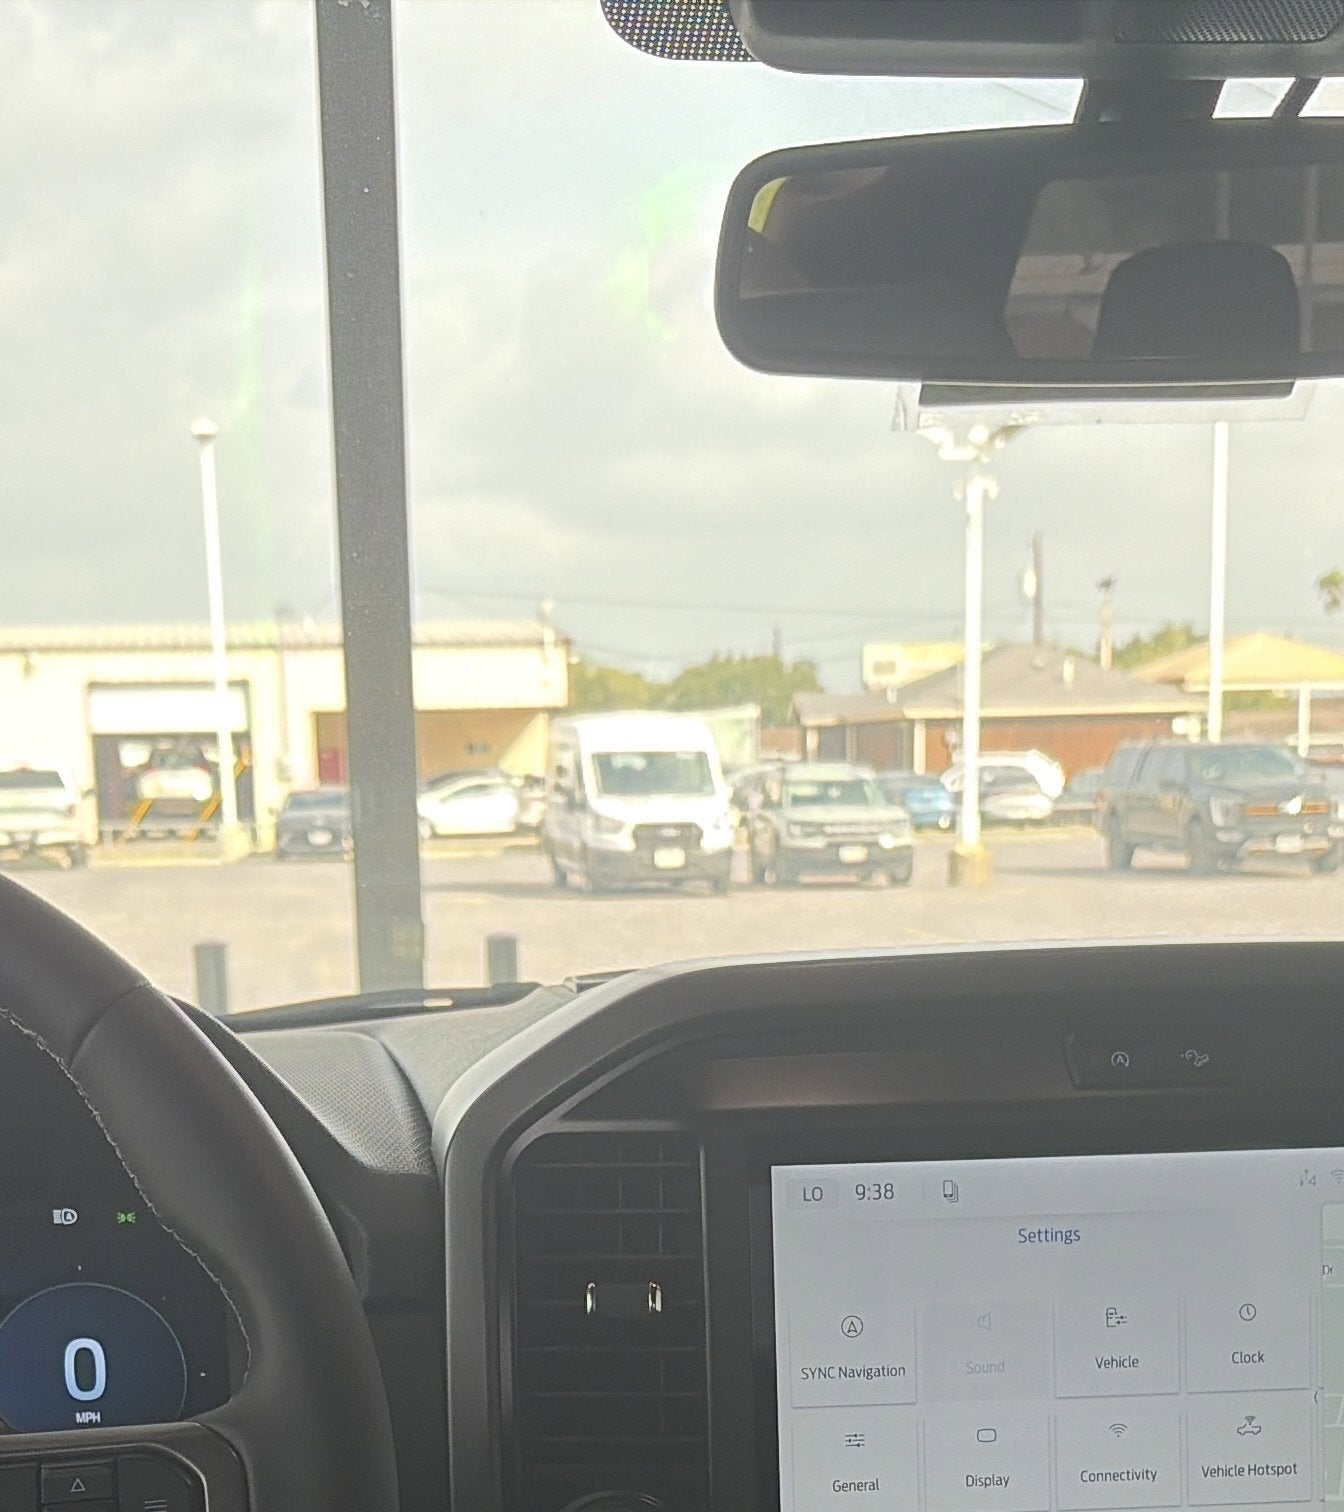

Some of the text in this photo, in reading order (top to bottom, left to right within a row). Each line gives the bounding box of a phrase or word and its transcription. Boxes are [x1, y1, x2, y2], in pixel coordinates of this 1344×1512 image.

[802, 1186, 824, 1203] LO
[855, 1183, 895, 1201] 9:38
[1017, 1227, 1082, 1246] Settings
[1094, 1355, 1140, 1369] Vehicle
[1231, 1350, 1265, 1364] Clock
[63, 1336, 107, 1402] 0
[800, 1364, 907, 1381] SYNC Navigation
[965, 1361, 1006, 1376] Sound
[75, 1411, 102, 1424] MPH
[1080, 1468, 1158, 1483] Connectivity
[1201, 1463, 1298, 1479] Vehicle Hotspot
[832, 1478, 880, 1493] General
[965, 1474, 1010, 1489] Display
